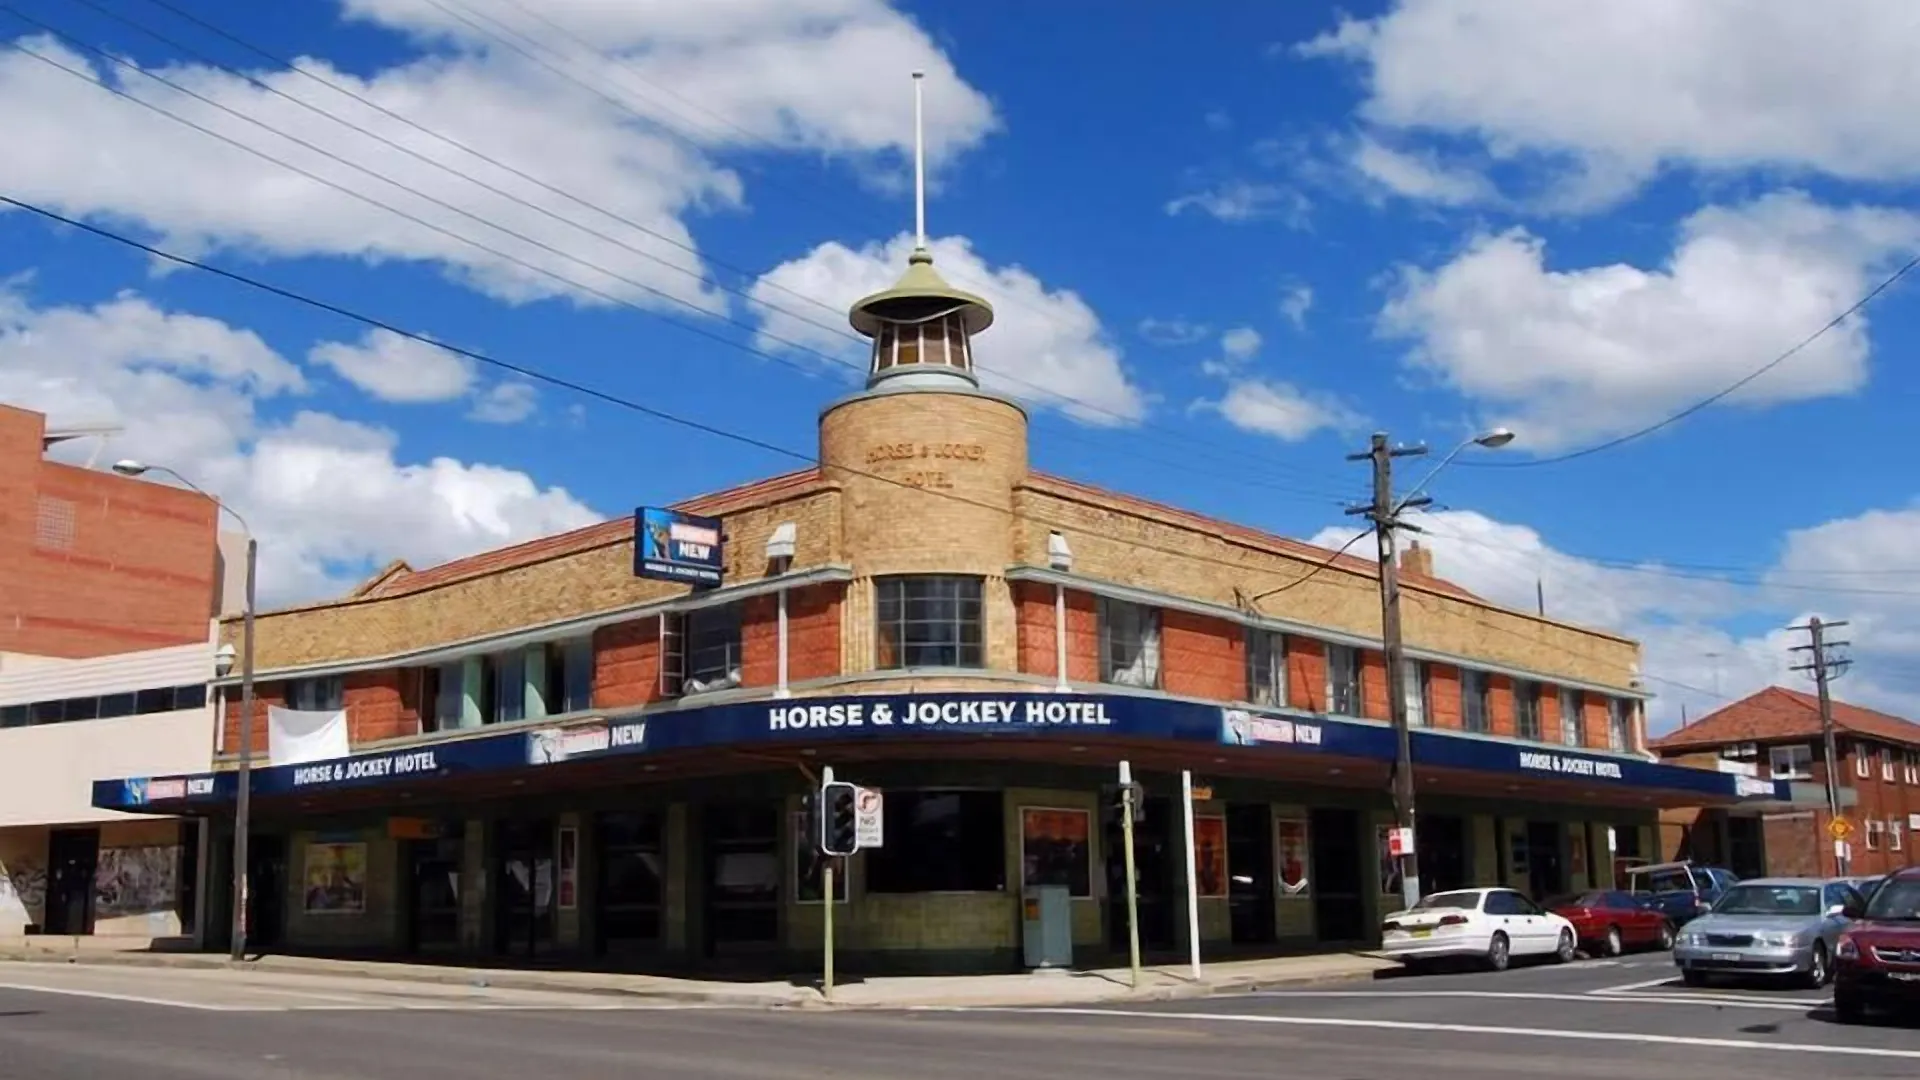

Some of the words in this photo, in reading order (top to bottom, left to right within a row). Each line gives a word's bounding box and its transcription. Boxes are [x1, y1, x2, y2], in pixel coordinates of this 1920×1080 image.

[679, 541, 711, 560] NEW
[769, 704, 863, 729] HORSE
[871, 703, 893, 725] &
[902, 701, 1016, 724] JOCKEY
[1026, 702, 1111, 725] HOTEL
[612, 723, 645, 747] NEW
[1295, 724, 1322, 745] NEW
[294, 764, 332, 785] HORSE
[333, 764, 343, 781] &
[345, 757, 393, 779] JOCKEY
[395, 751, 437, 773] HOTEL
[187, 778, 215, 795] NEW
